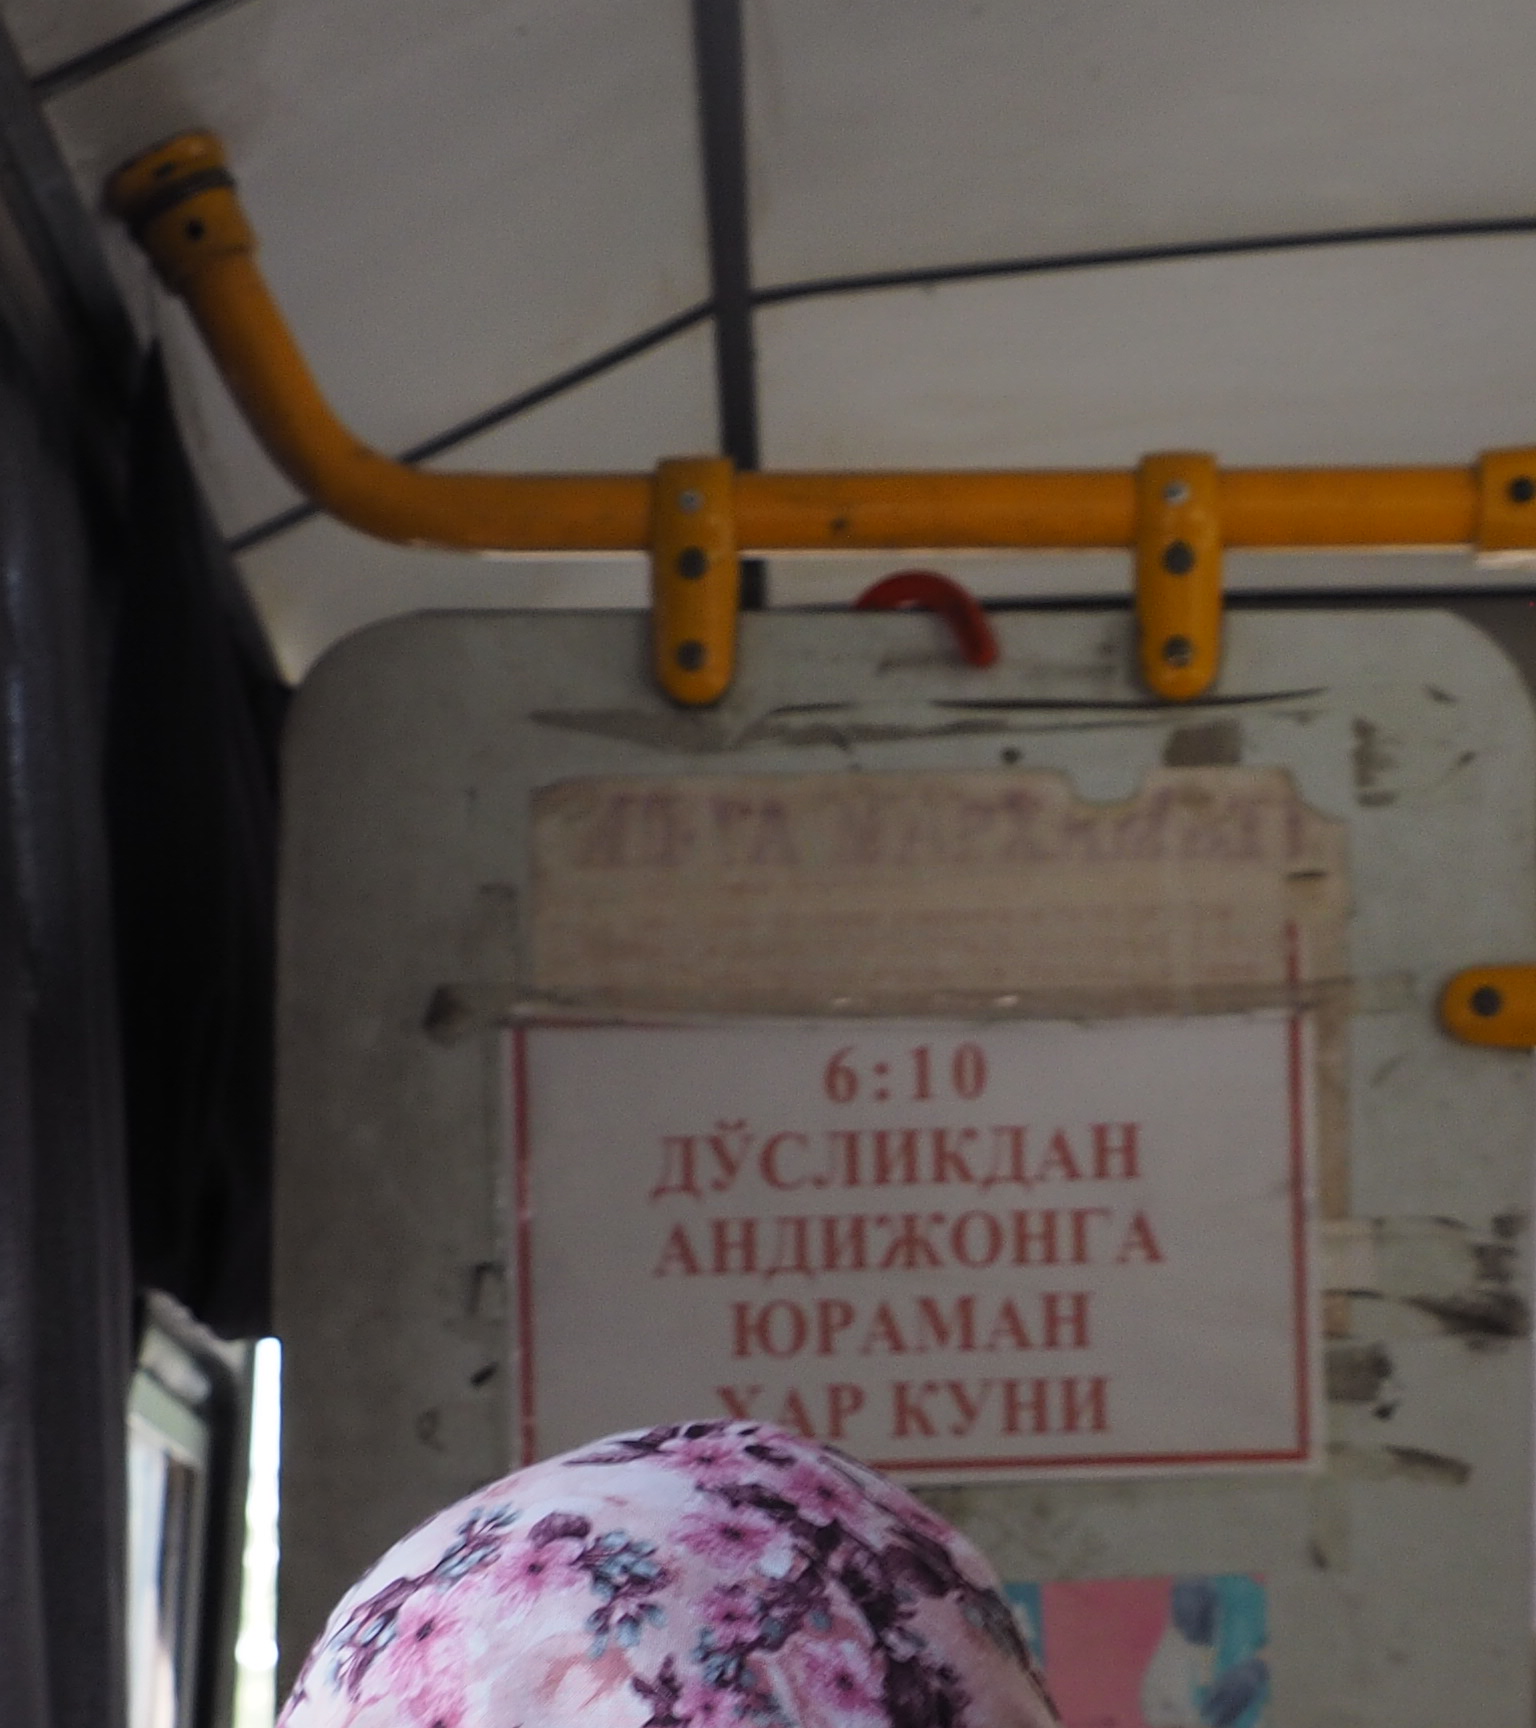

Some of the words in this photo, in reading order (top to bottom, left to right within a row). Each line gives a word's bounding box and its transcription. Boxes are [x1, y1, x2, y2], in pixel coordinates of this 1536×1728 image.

[822, 1044, 988, 1103] 6:10
[651, 1118, 1142, 1199] ДЎСЛИКДАН
[654, 1207, 1166, 1280] АНДИЖОНГА
[731, 1291, 1094, 1358] ЮРАМАН
[891, 1376, 1110, 1438] КУНИ
